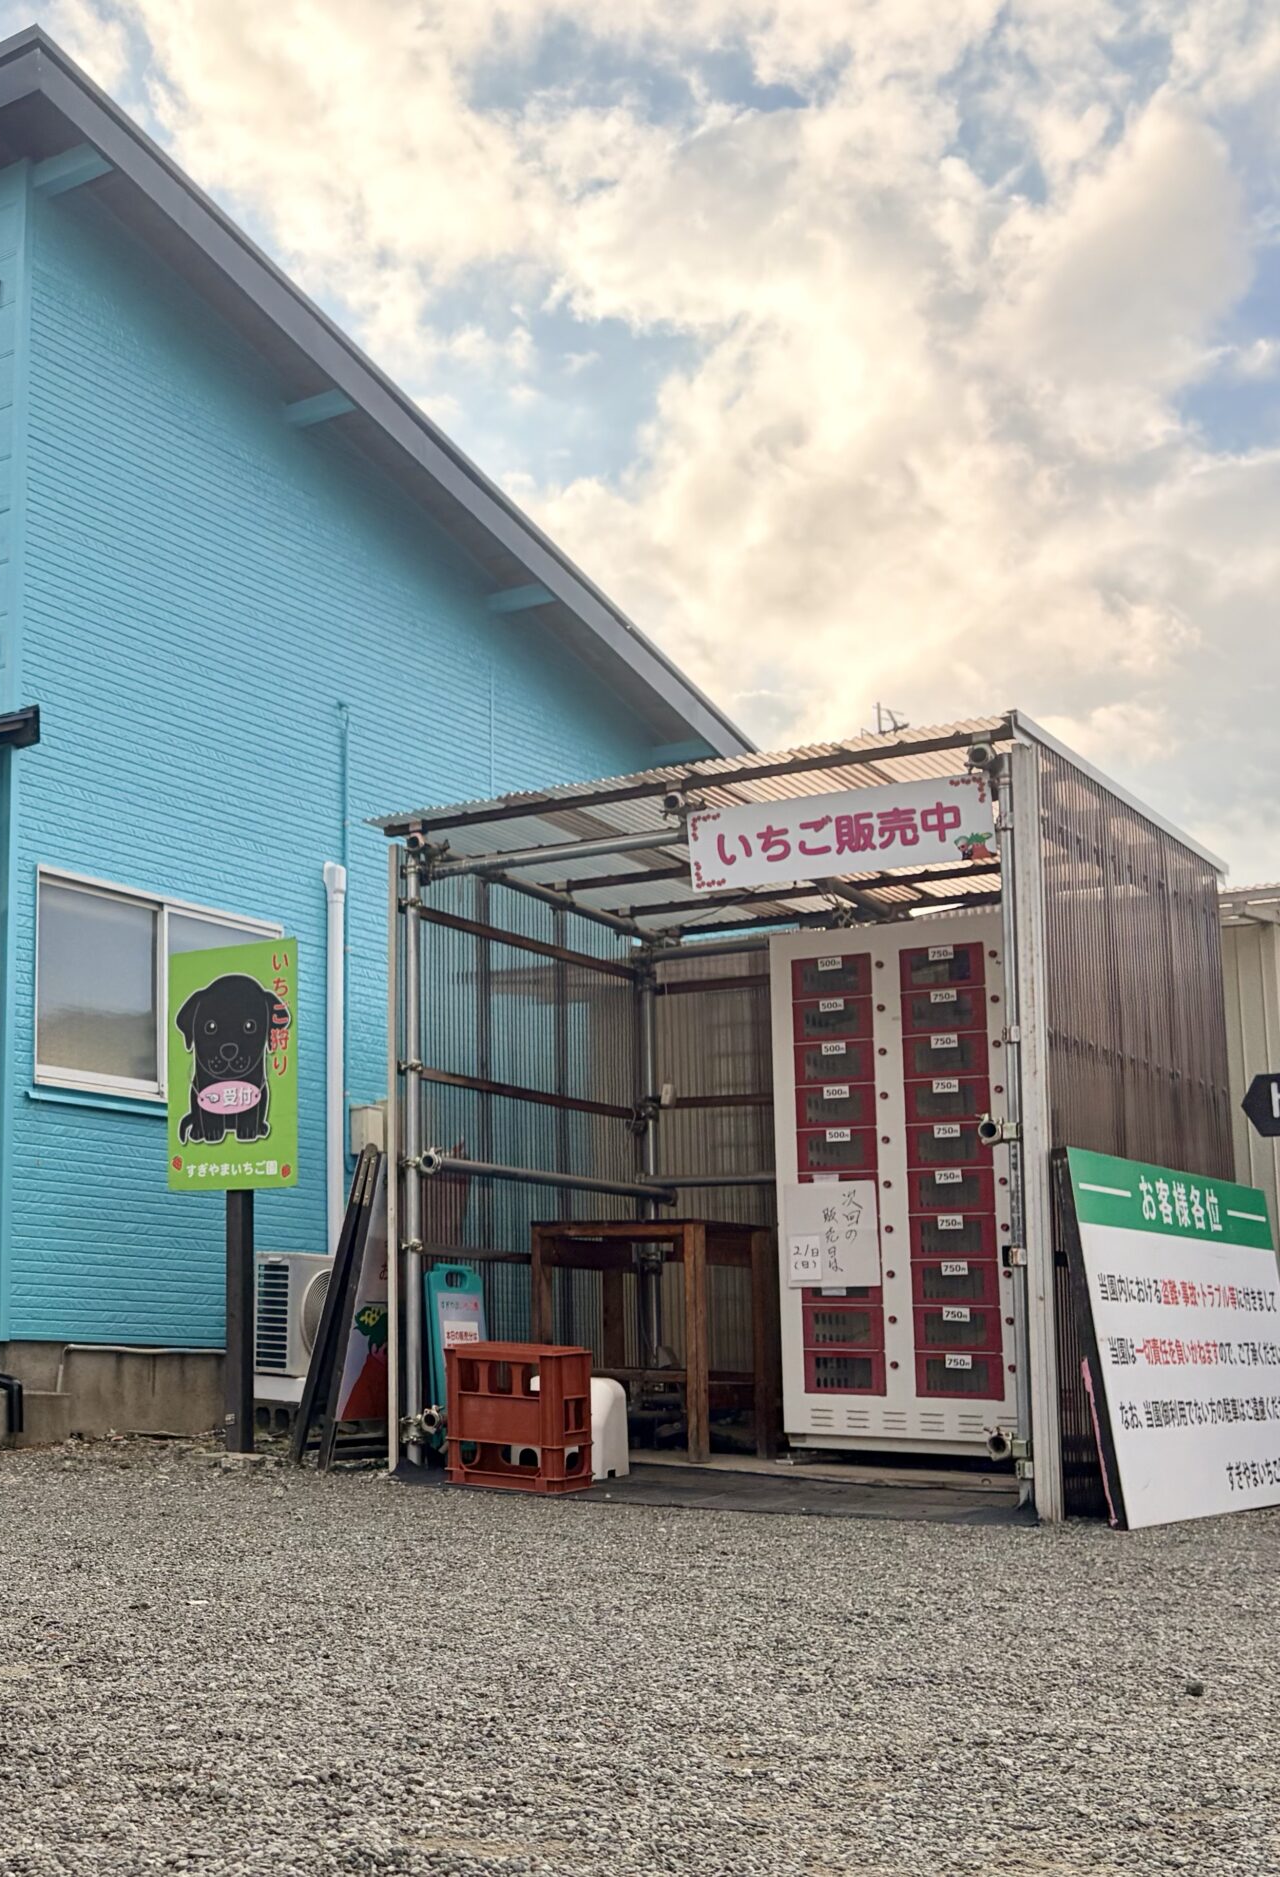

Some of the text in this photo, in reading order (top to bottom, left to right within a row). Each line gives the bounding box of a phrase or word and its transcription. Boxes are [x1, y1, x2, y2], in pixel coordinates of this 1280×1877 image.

[716, 801, 961, 866] いちご販売中
[270, 952, 289, 1076] いちご狩り
[223, 1087, 253, 1107] 受付
[186, 1160, 277, 1178] すぎやまいちご園
[842, 1189, 863, 1244] 次回の
[1139, 1174, 1223, 1232] お客様各位
